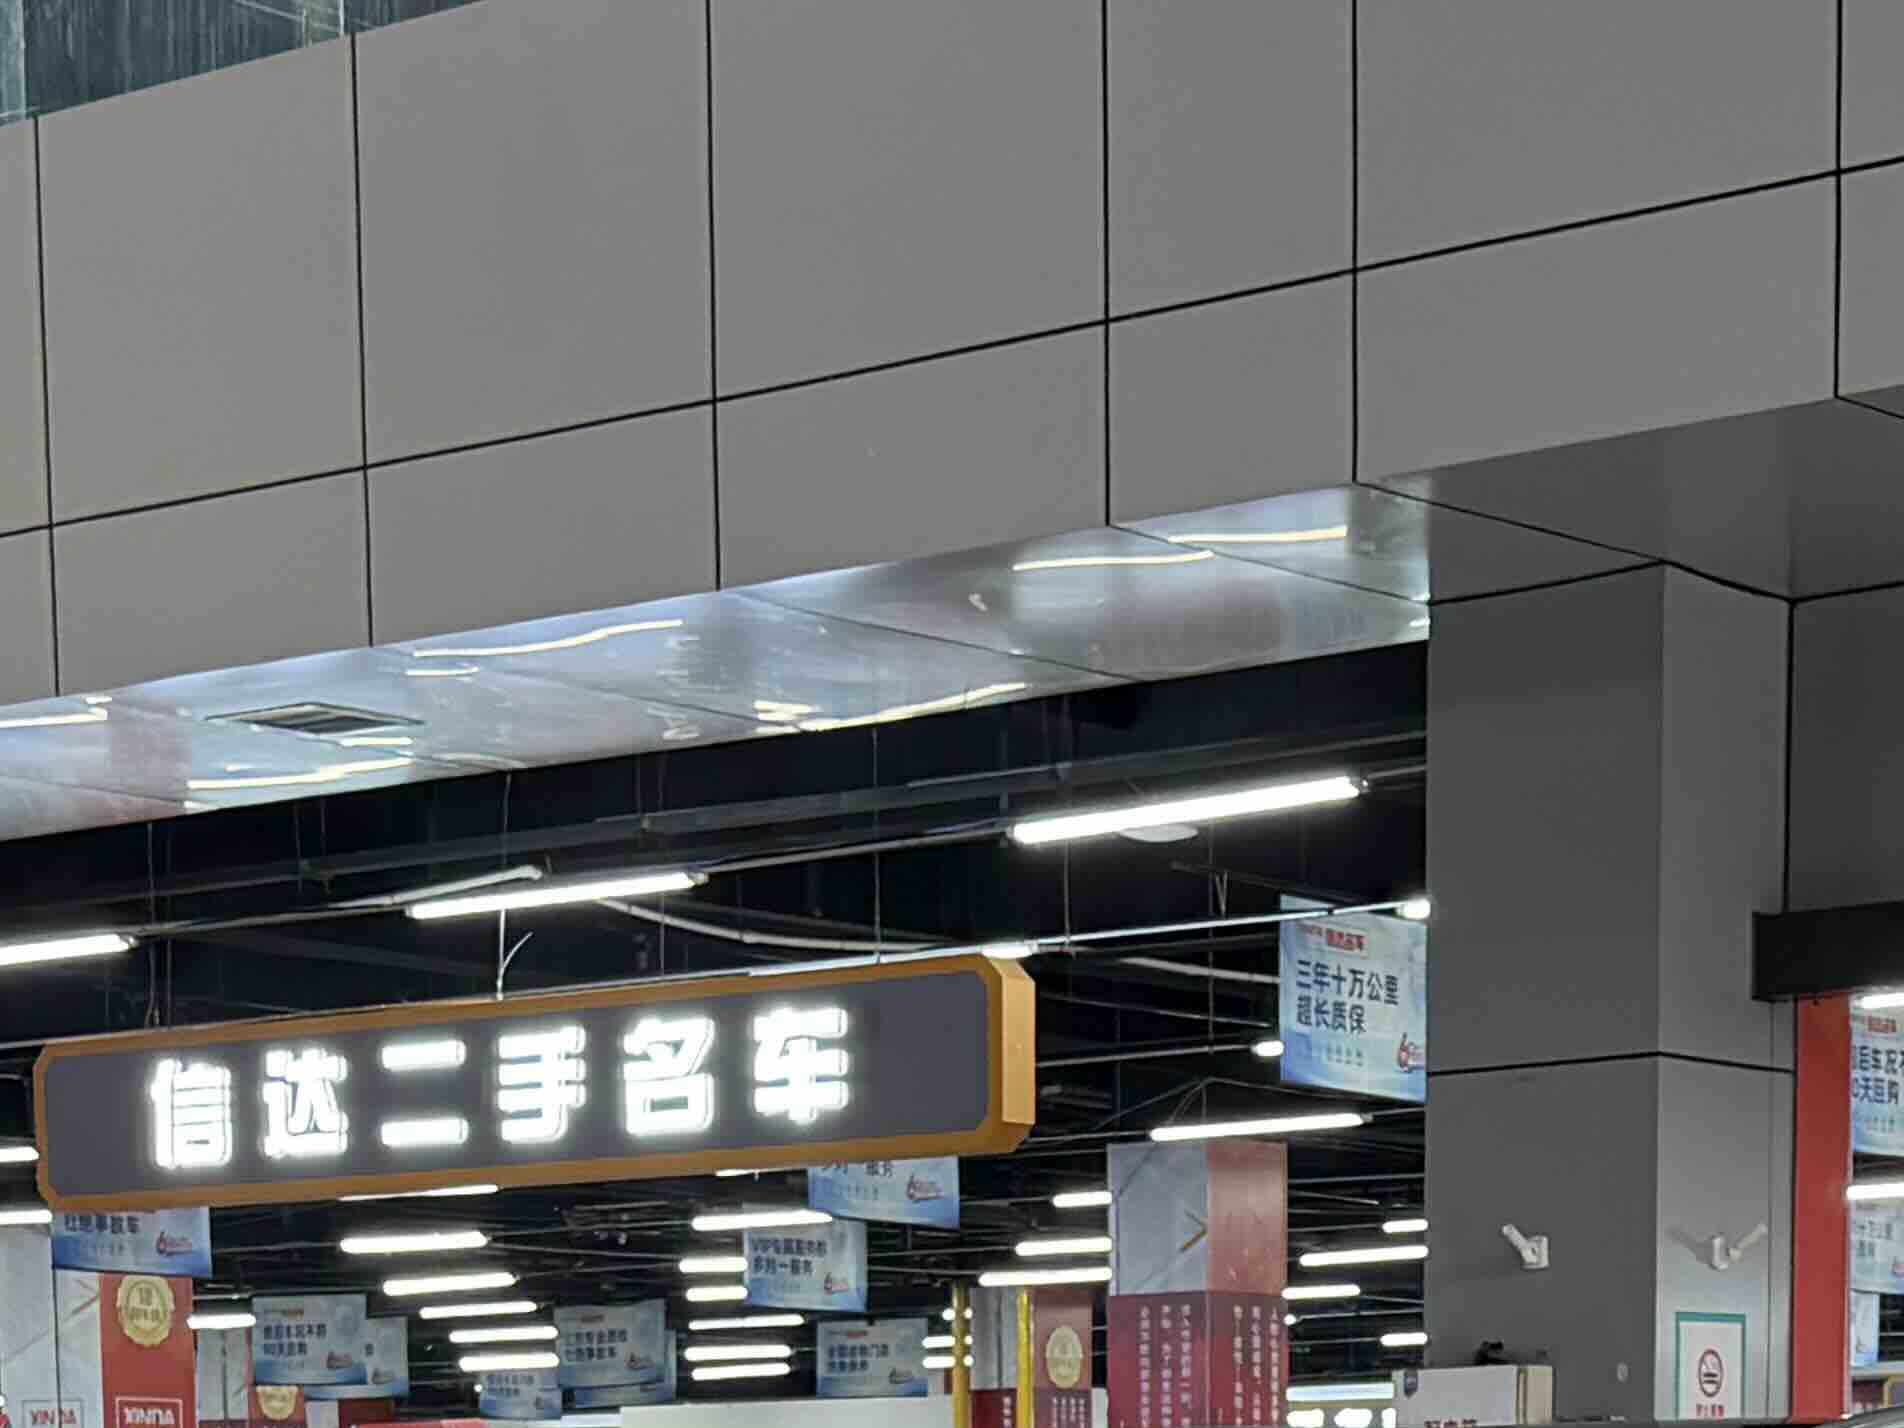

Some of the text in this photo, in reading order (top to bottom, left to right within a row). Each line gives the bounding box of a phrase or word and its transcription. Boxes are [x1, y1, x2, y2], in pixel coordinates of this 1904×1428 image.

[1296, 959, 1399, 1006] 三年十万公里
[1296, 995, 1366, 1035] 超长质保
[148, 1005, 853, 1173] 信达二手名车
